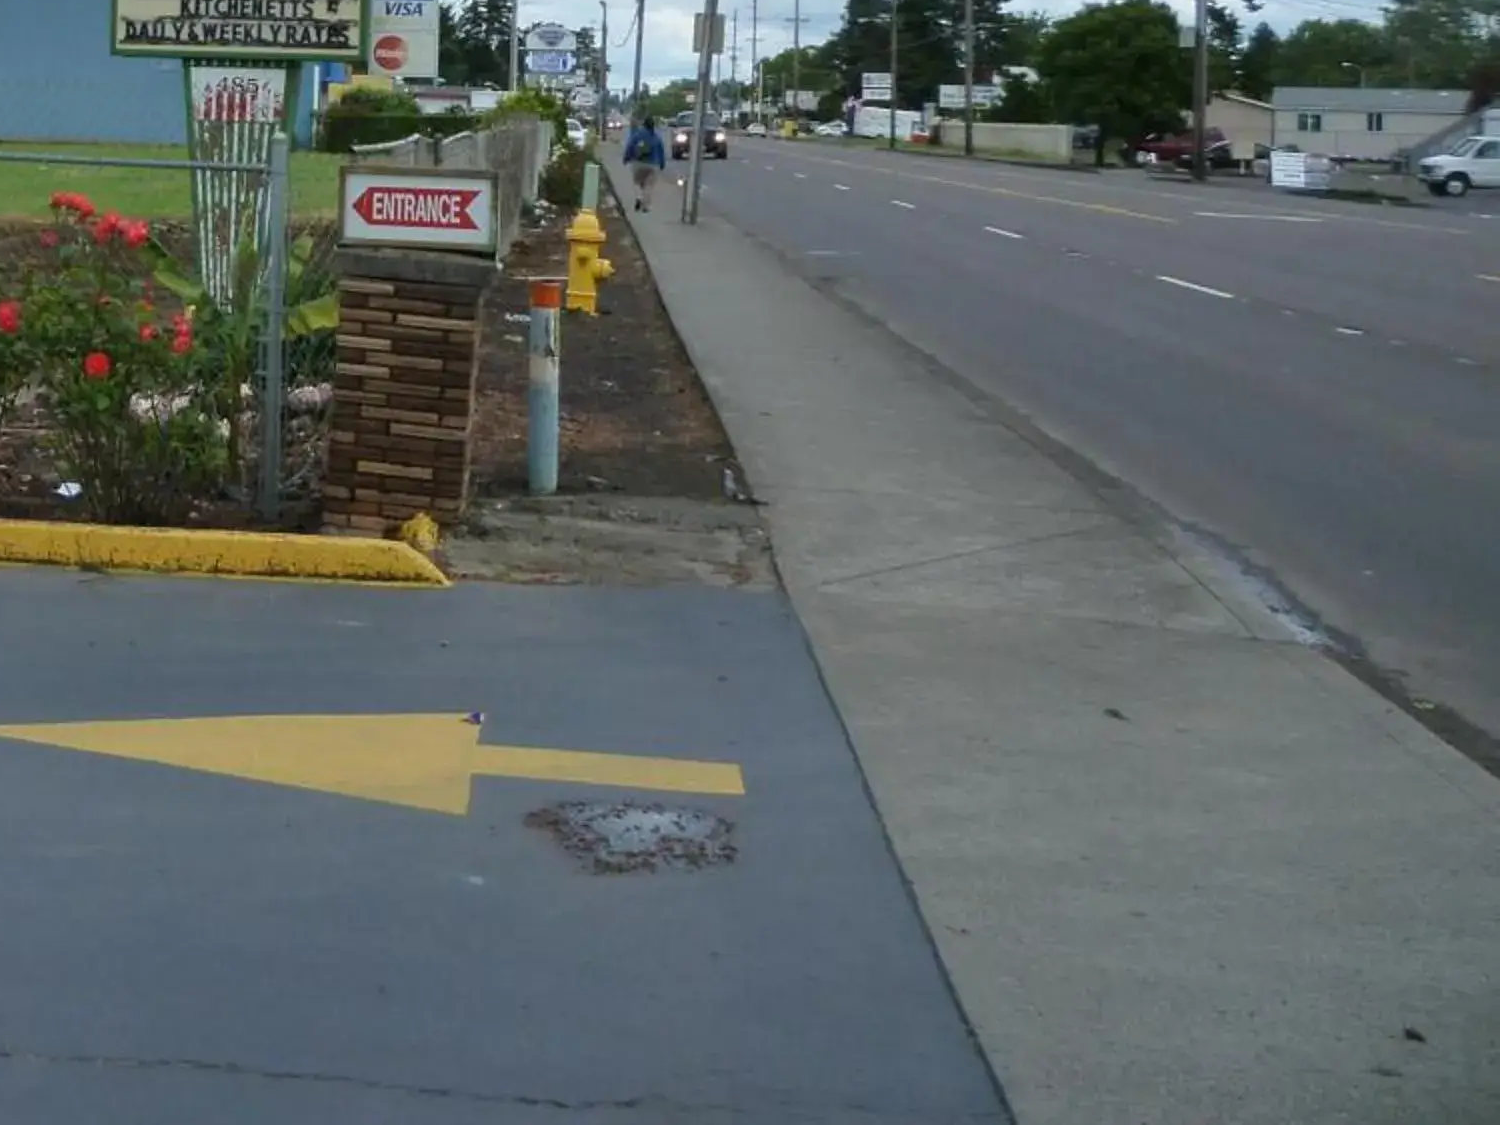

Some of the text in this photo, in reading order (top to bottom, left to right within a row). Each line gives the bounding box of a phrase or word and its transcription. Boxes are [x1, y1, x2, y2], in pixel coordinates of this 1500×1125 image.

[384, 1, 424, 17] VISA
[125, 22, 184, 43] DAILY
[201, 23, 282, 44] WEEKLY
[371, 191, 462, 224] ENTRANCE
